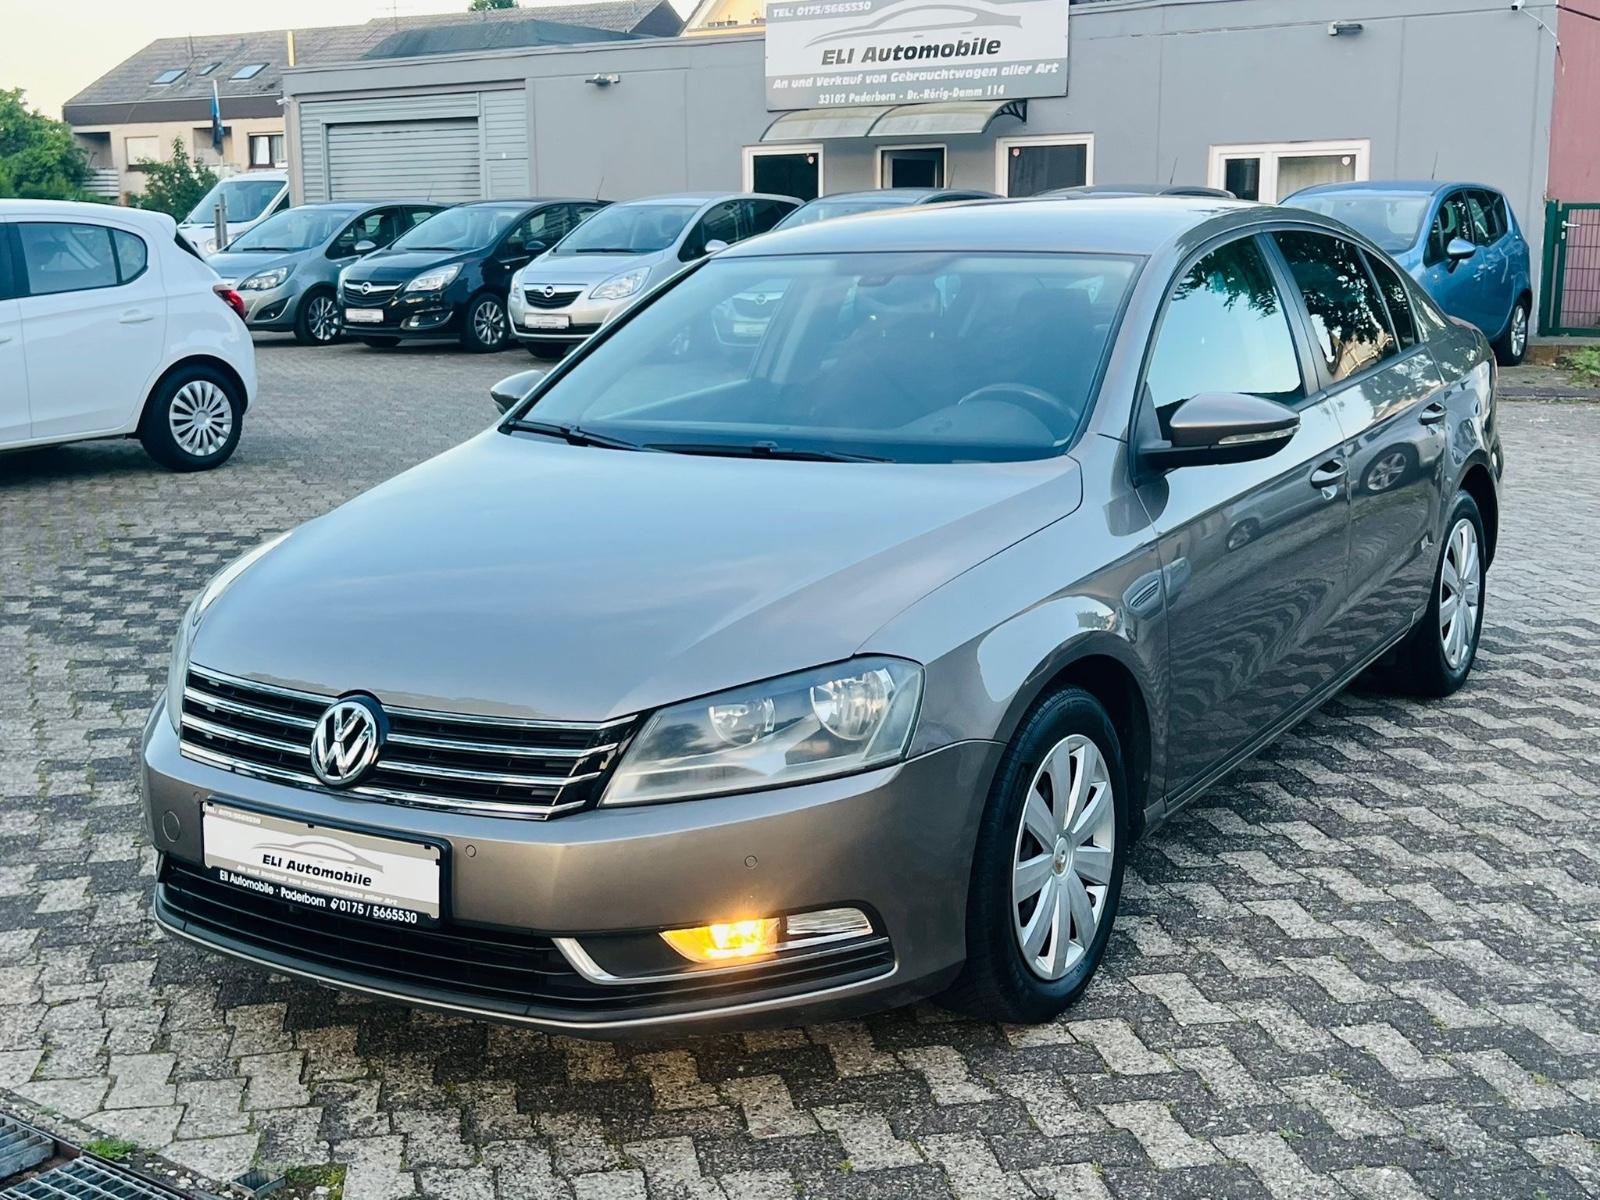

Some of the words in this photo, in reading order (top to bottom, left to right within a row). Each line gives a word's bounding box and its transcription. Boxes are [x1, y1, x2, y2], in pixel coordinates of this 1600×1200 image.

[821, 48, 855, 66] ELI
[861, 37, 1001, 63] Automobile
[773, 79, 788, 89] An
[791, 77, 814, 88] und
[816, 73, 863, 87] Verkauf
[865, 75, 887, 84] von
[890, 66, 998, 83] Gebrauchtwagen
[1001, 64, 1032, 76] aller
[1035, 62, 1060, 75] Art
[818, 93, 846, 105] 33102
[848, 91, 896, 103] Paderborn
[987, 84, 1005, 96] 114
[262, 853, 282, 868] ELI
[286, 859, 372, 887] Automobile
[229, 872, 274, 895] Automobile
[280, 886, 326, 908] Paderborn
[339, 899, 364, 915] 0175
[372, 905, 418, 924] 5665530
